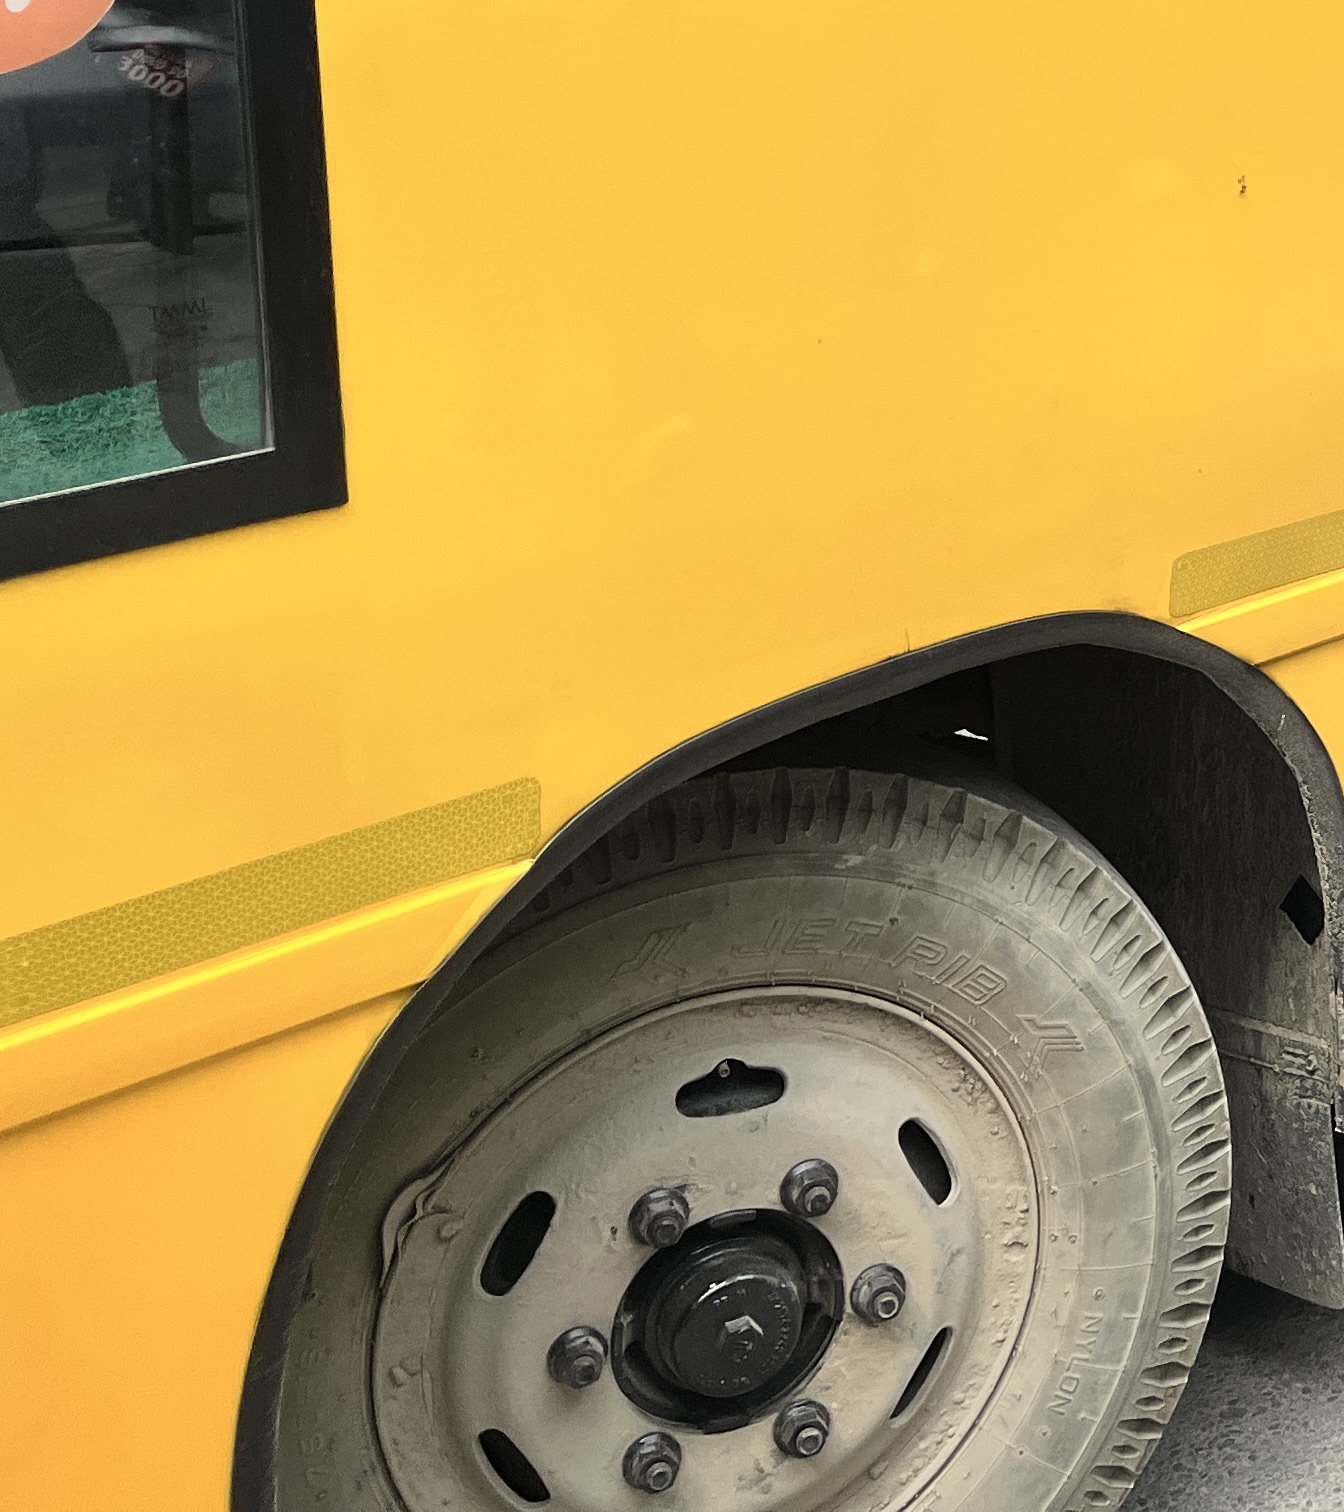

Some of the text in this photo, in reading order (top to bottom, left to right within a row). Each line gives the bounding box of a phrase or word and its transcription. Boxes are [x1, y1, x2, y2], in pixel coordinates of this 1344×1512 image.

[730, 916, 883, 960] JET
[893, 933, 1009, 1006] RIB
[1047, 1312, 1105, 1417] NYLON
